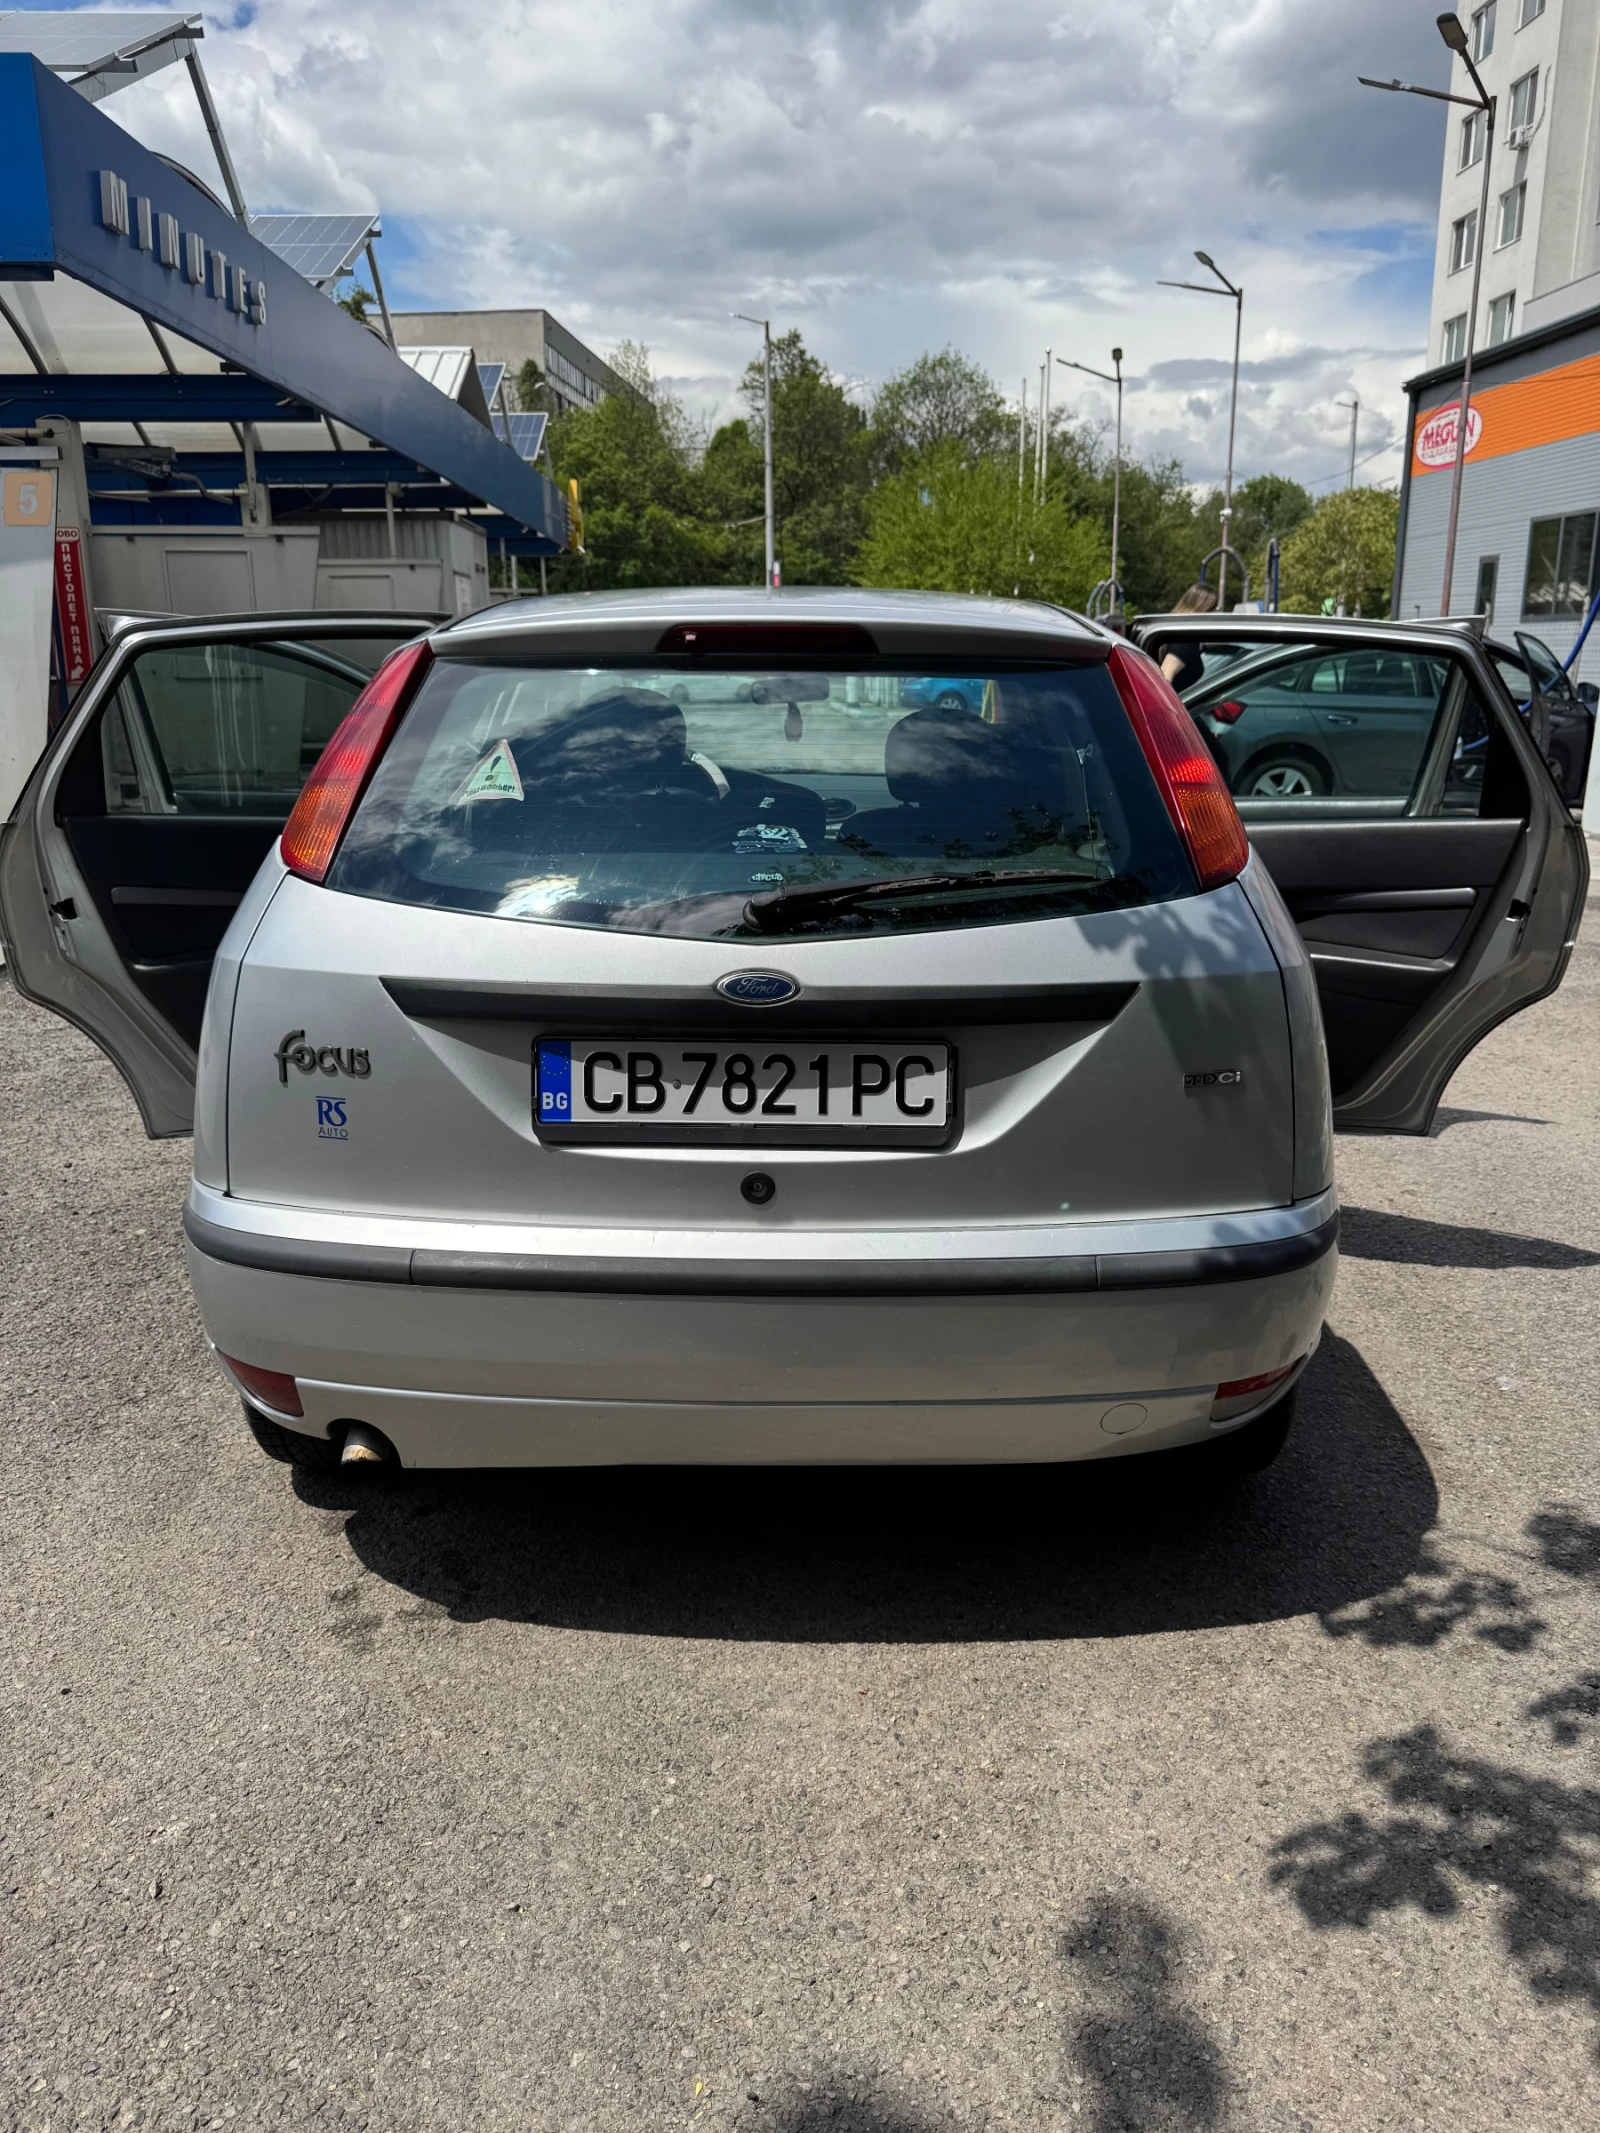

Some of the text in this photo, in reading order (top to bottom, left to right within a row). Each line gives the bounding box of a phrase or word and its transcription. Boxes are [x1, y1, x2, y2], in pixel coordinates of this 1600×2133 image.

[100, 170, 267, 326] MINUTES
[18, 483, 39, 516] 5
[56, 530, 78, 538] ОВО
[61, 543, 83, 664] ПИСТОЛЕТ ПЯНА
[737, 977, 779, 994] Ford
[583, 1051, 936, 1116] CB 7821 PC
[316, 1099, 347, 1126] RS
[542, 1091, 568, 1110] BG
[318, 1126, 349, 1138] AUTO
